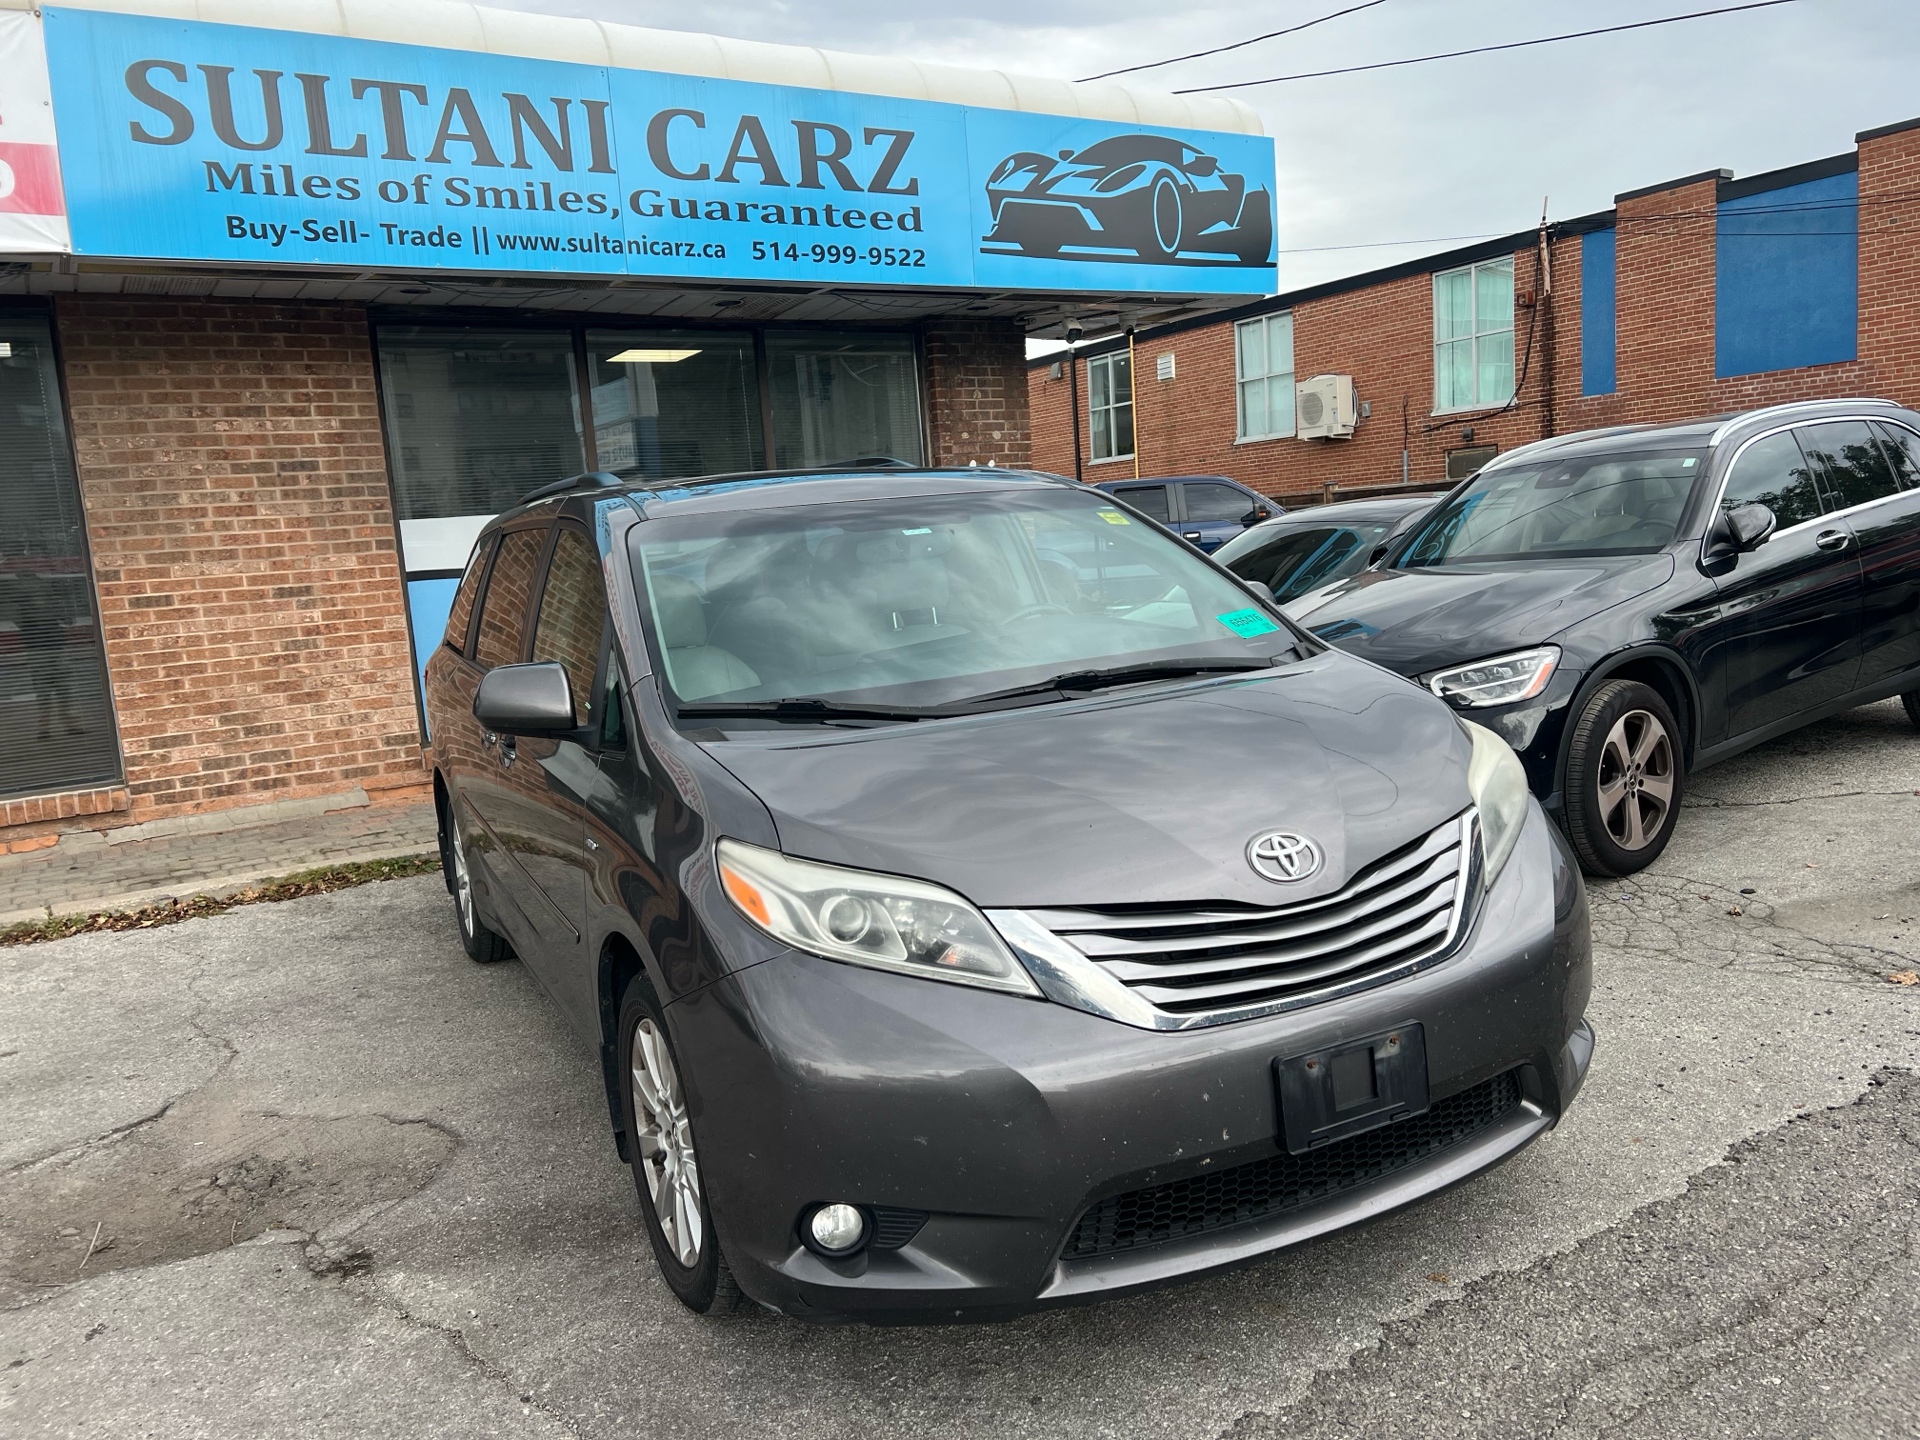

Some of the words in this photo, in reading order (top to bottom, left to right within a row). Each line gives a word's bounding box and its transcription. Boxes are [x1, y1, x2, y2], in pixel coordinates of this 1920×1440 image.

[124, 59, 617, 174] SULTANI
[646, 108, 919, 197] CARZ
[203, 161, 361, 201] Miles
[378, 174, 433, 206] of
[444, 177, 620, 220] Smiles,
[629, 189, 924, 232] Guaranteed
[379, 223, 463, 248] Trade
[496, 228, 726, 259] www.sultanicarz.ca
[752, 240, 926, 268] 514-999-9522
